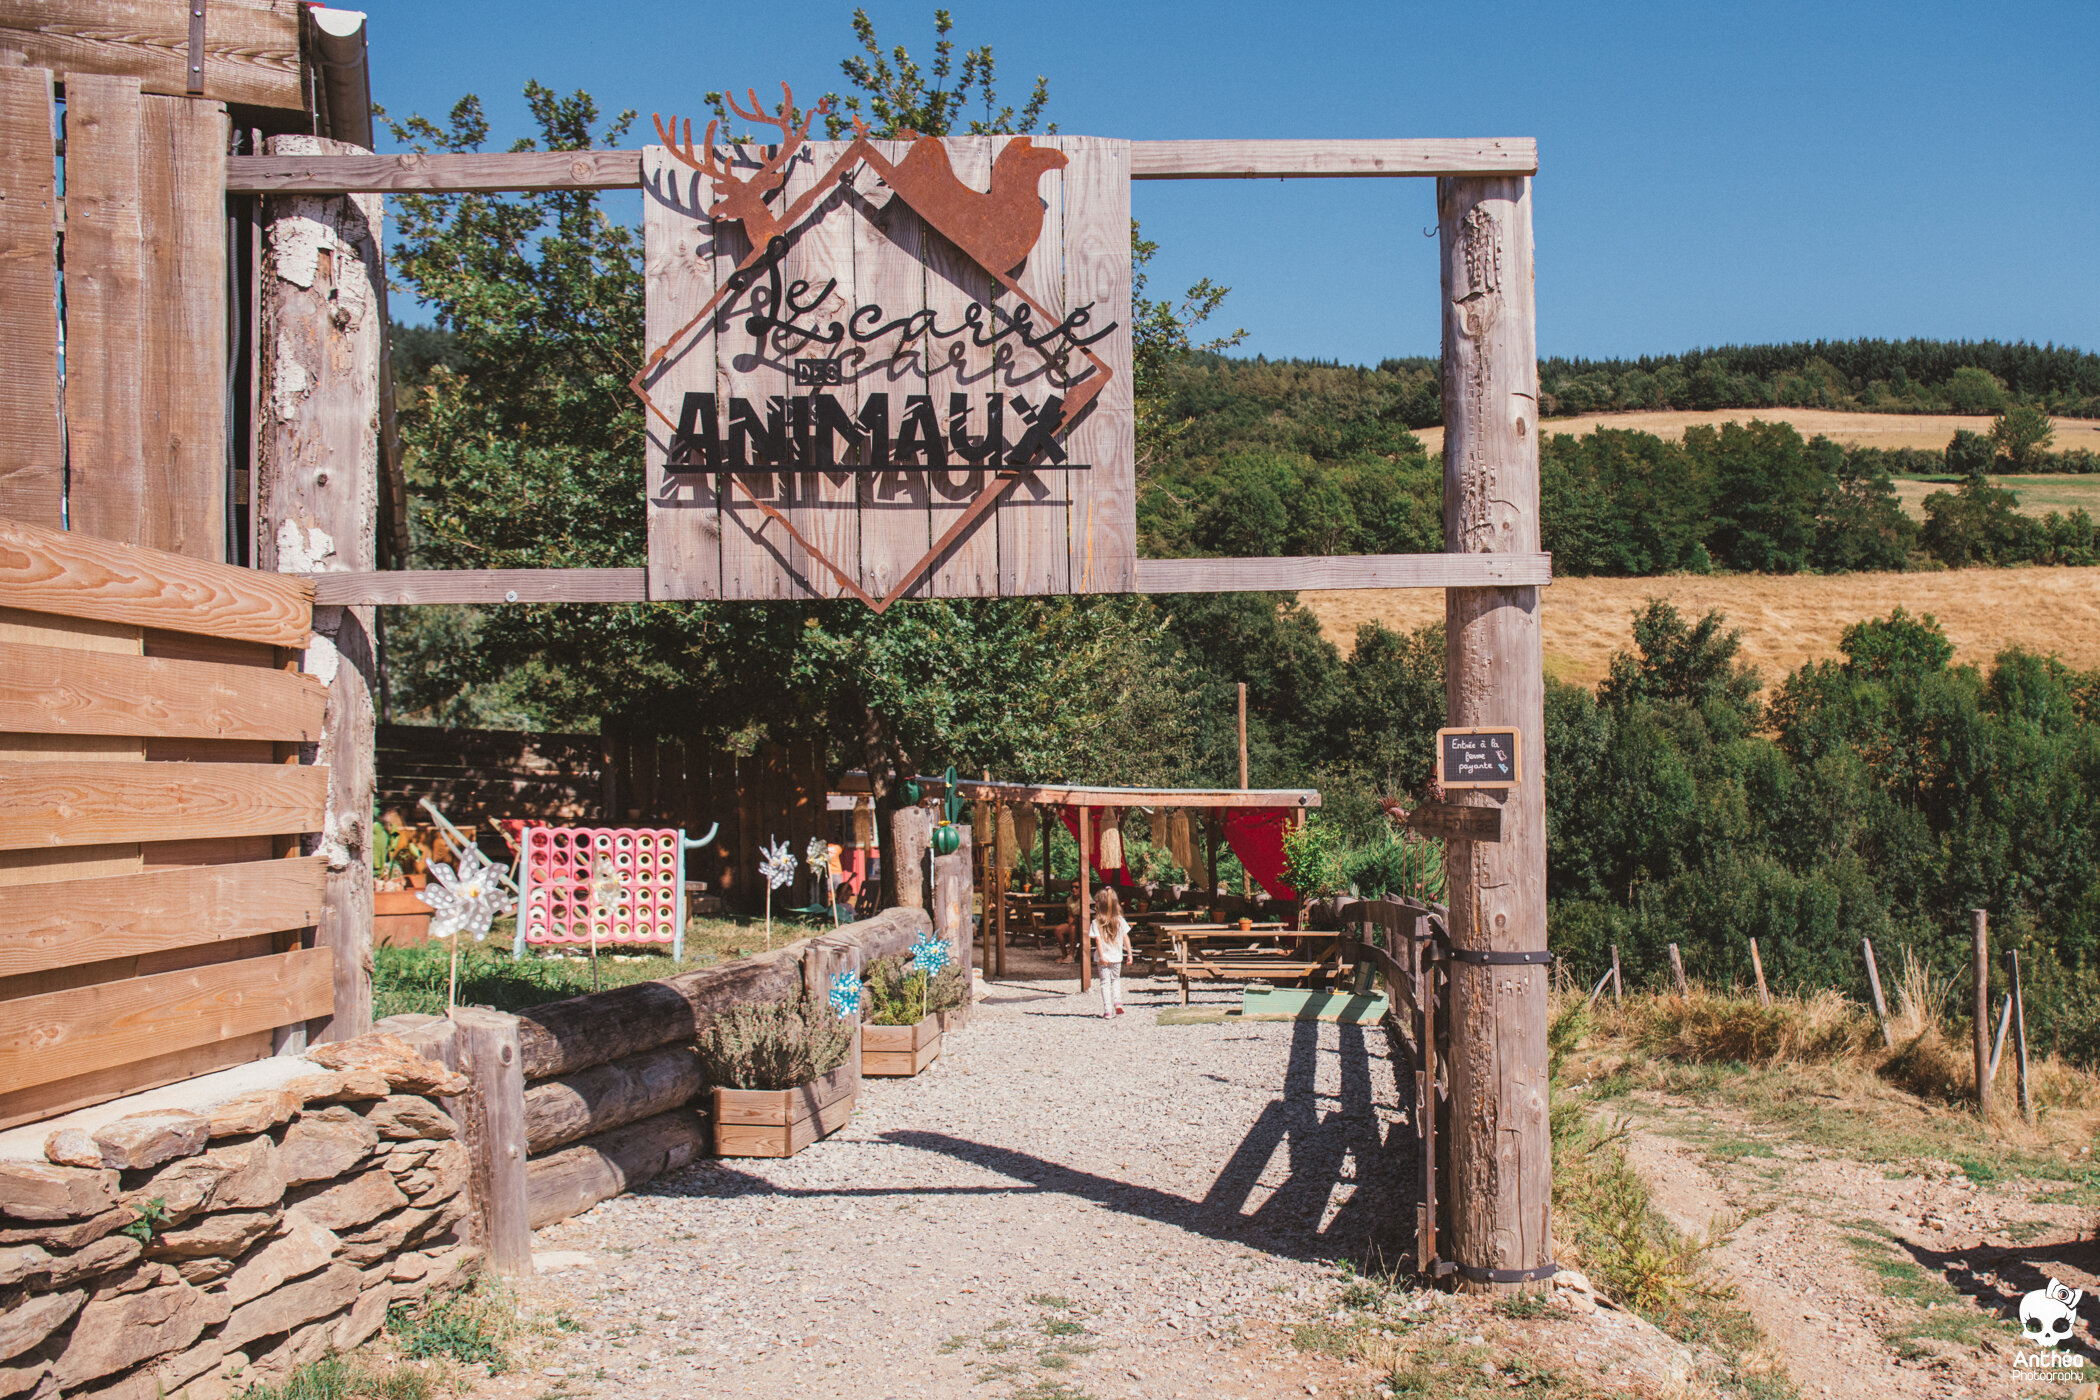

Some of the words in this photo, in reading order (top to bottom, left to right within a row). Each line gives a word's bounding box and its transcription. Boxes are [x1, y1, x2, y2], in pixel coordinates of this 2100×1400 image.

[727, 235, 844, 344] Le
[849, 301, 1119, 347] carré
[798, 362, 839, 384] DES
[671, 391, 1069, 467] ANIMAUX
[1451, 738, 1477, 749] Entrée
[1480, 740, 1487, 748] à
[1490, 738, 1500, 748] la
[1465, 751, 1486, 763] ferme
[1458, 762, 1494, 774] payante
